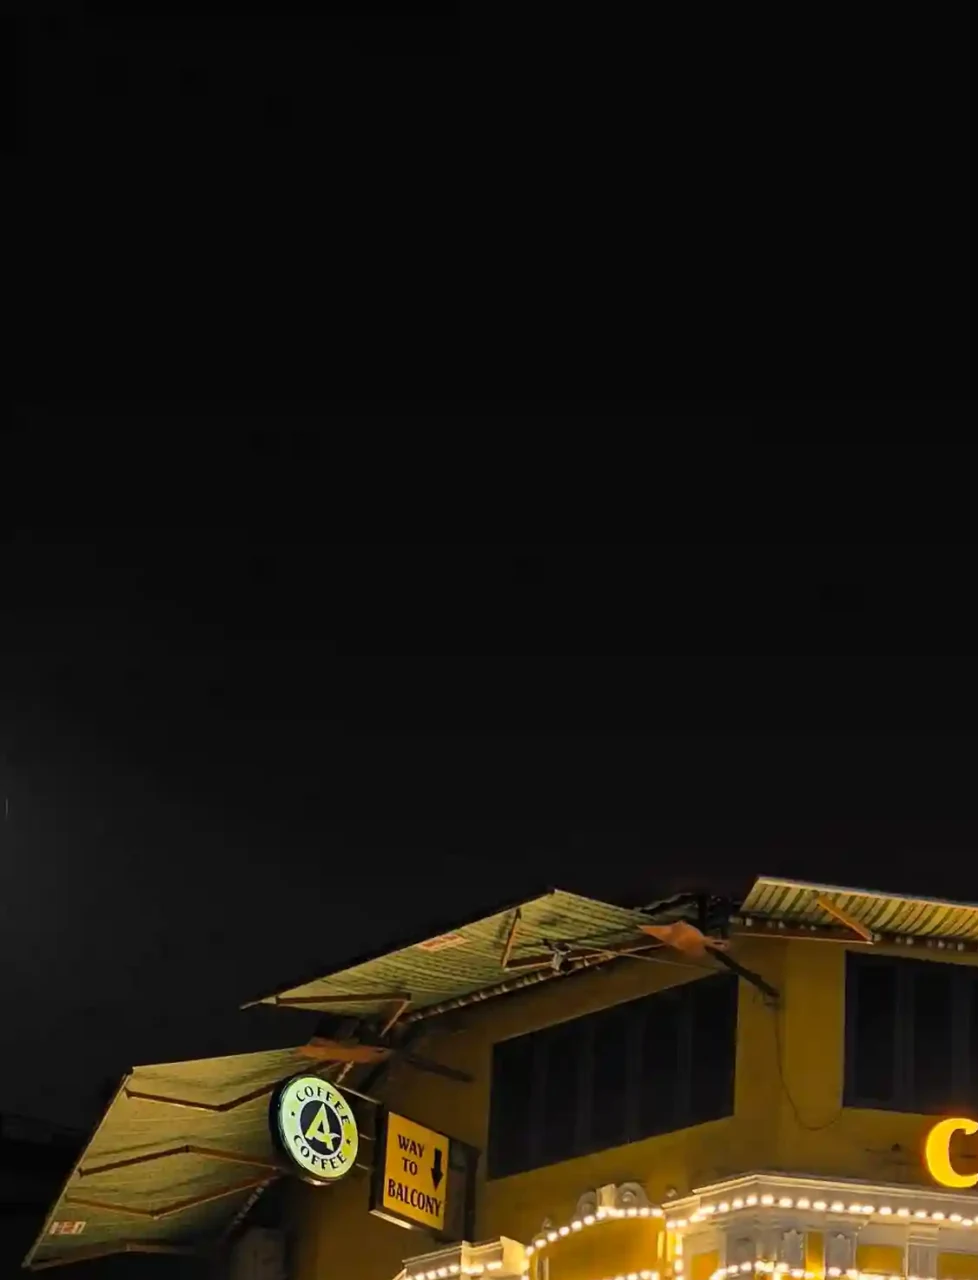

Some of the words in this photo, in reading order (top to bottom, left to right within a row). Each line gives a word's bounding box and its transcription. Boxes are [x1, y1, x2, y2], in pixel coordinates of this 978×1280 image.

[296, 1085, 351, 1126] COFFEE
[293, 1134, 347, 1170] COFFEE
[397, 1134, 425, 1159] WAY
[401, 1157, 418, 1176] TO
[387, 1178, 441, 1217] BALCONY
